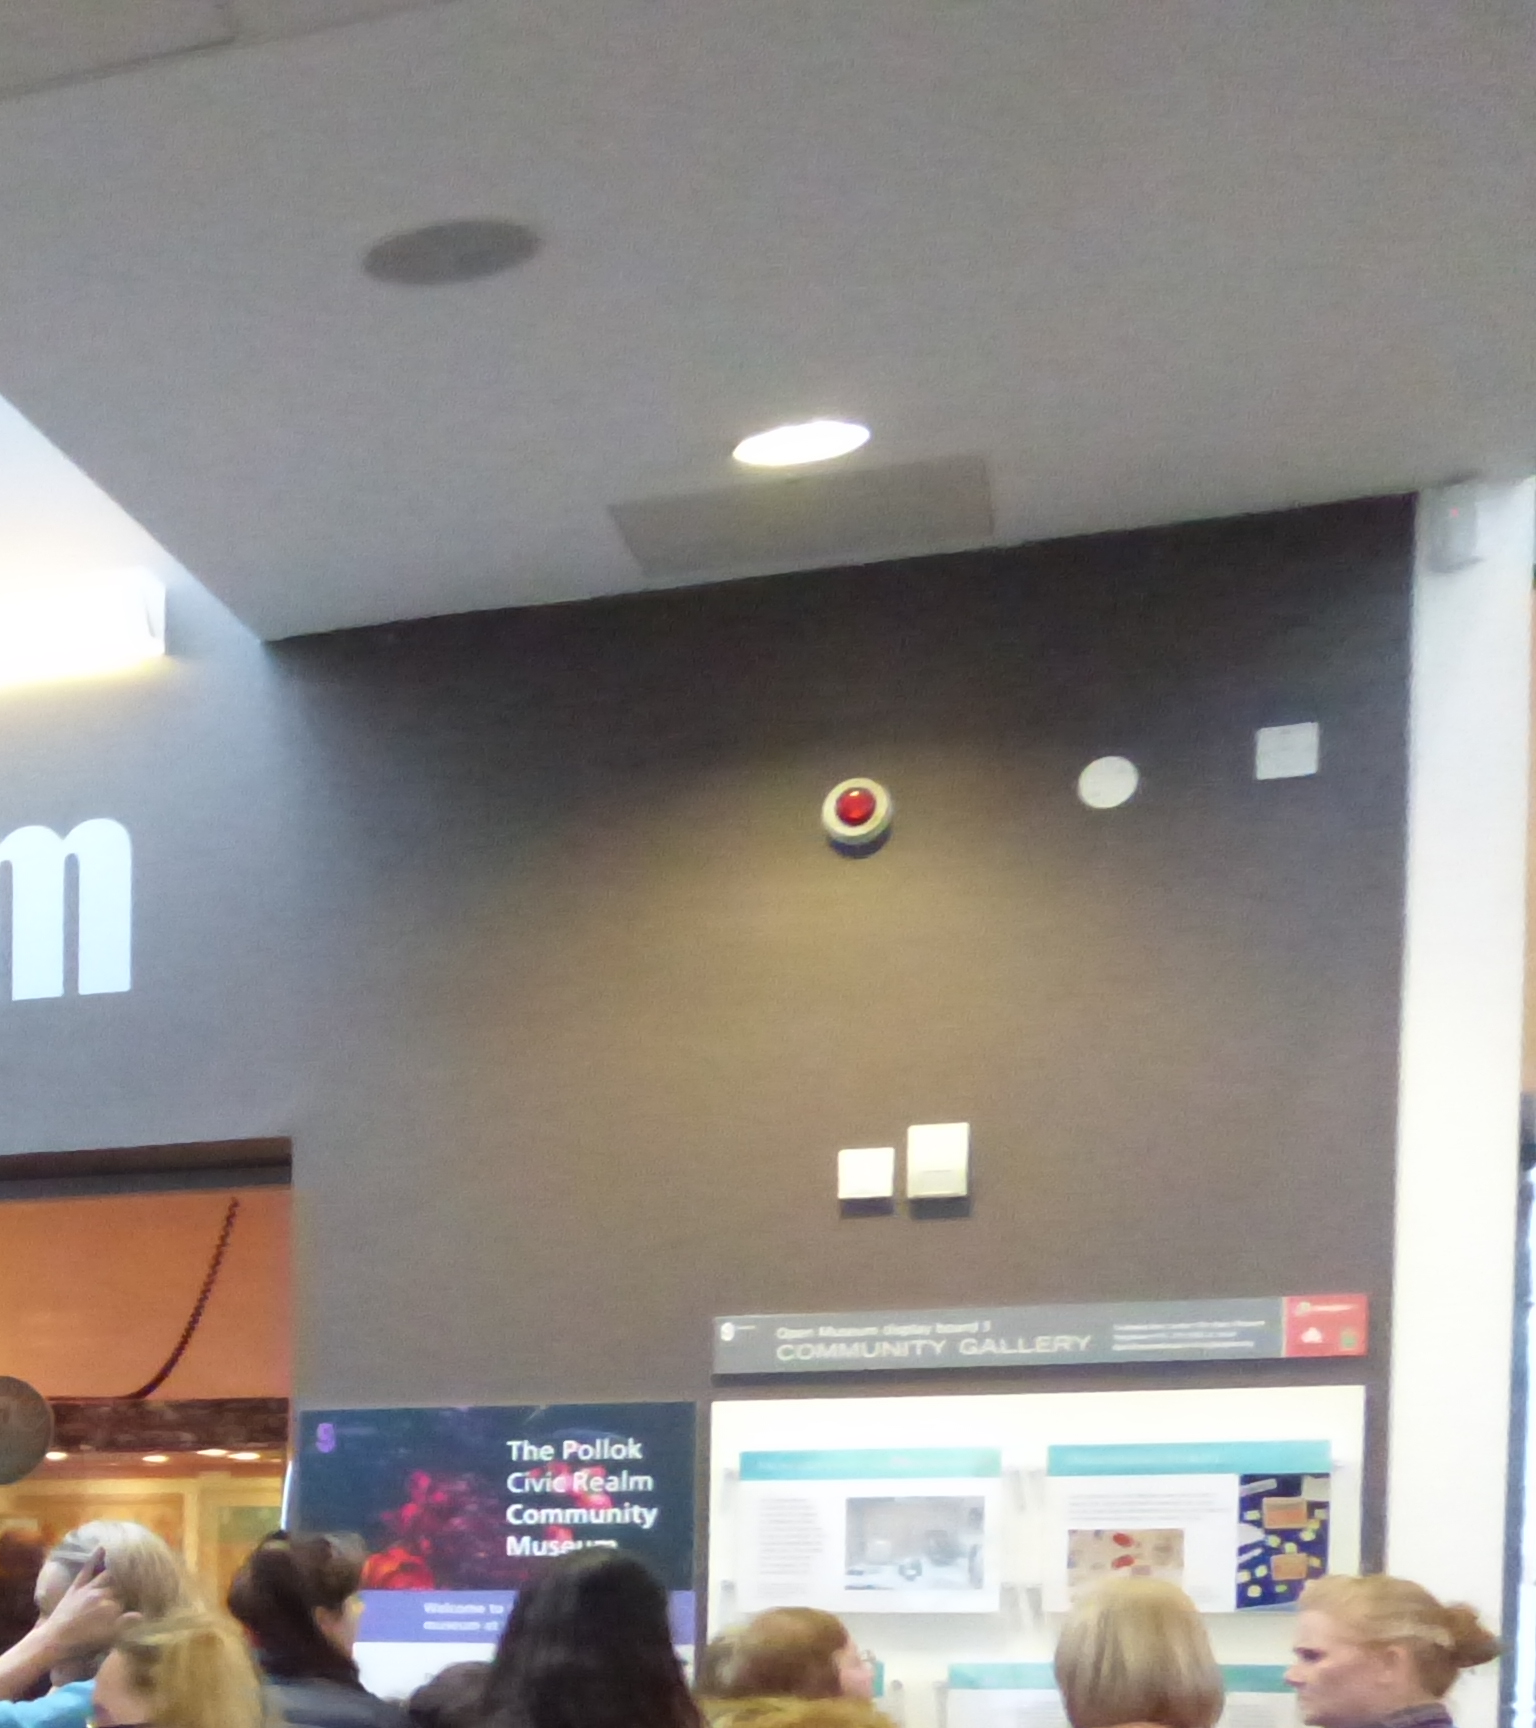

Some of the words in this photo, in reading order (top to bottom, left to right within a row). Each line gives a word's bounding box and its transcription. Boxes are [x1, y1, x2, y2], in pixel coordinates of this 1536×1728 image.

[776, 1339, 947, 1361] COMMUNITY
[959, 1335, 1092, 1355] GALLERY
[506, 1440, 555, 1461] The
[562, 1437, 644, 1461] Pollok
[506, 1471, 567, 1494] Civic
[572, 1469, 655, 1493] Realm
[506, 1502, 659, 1530] Community
